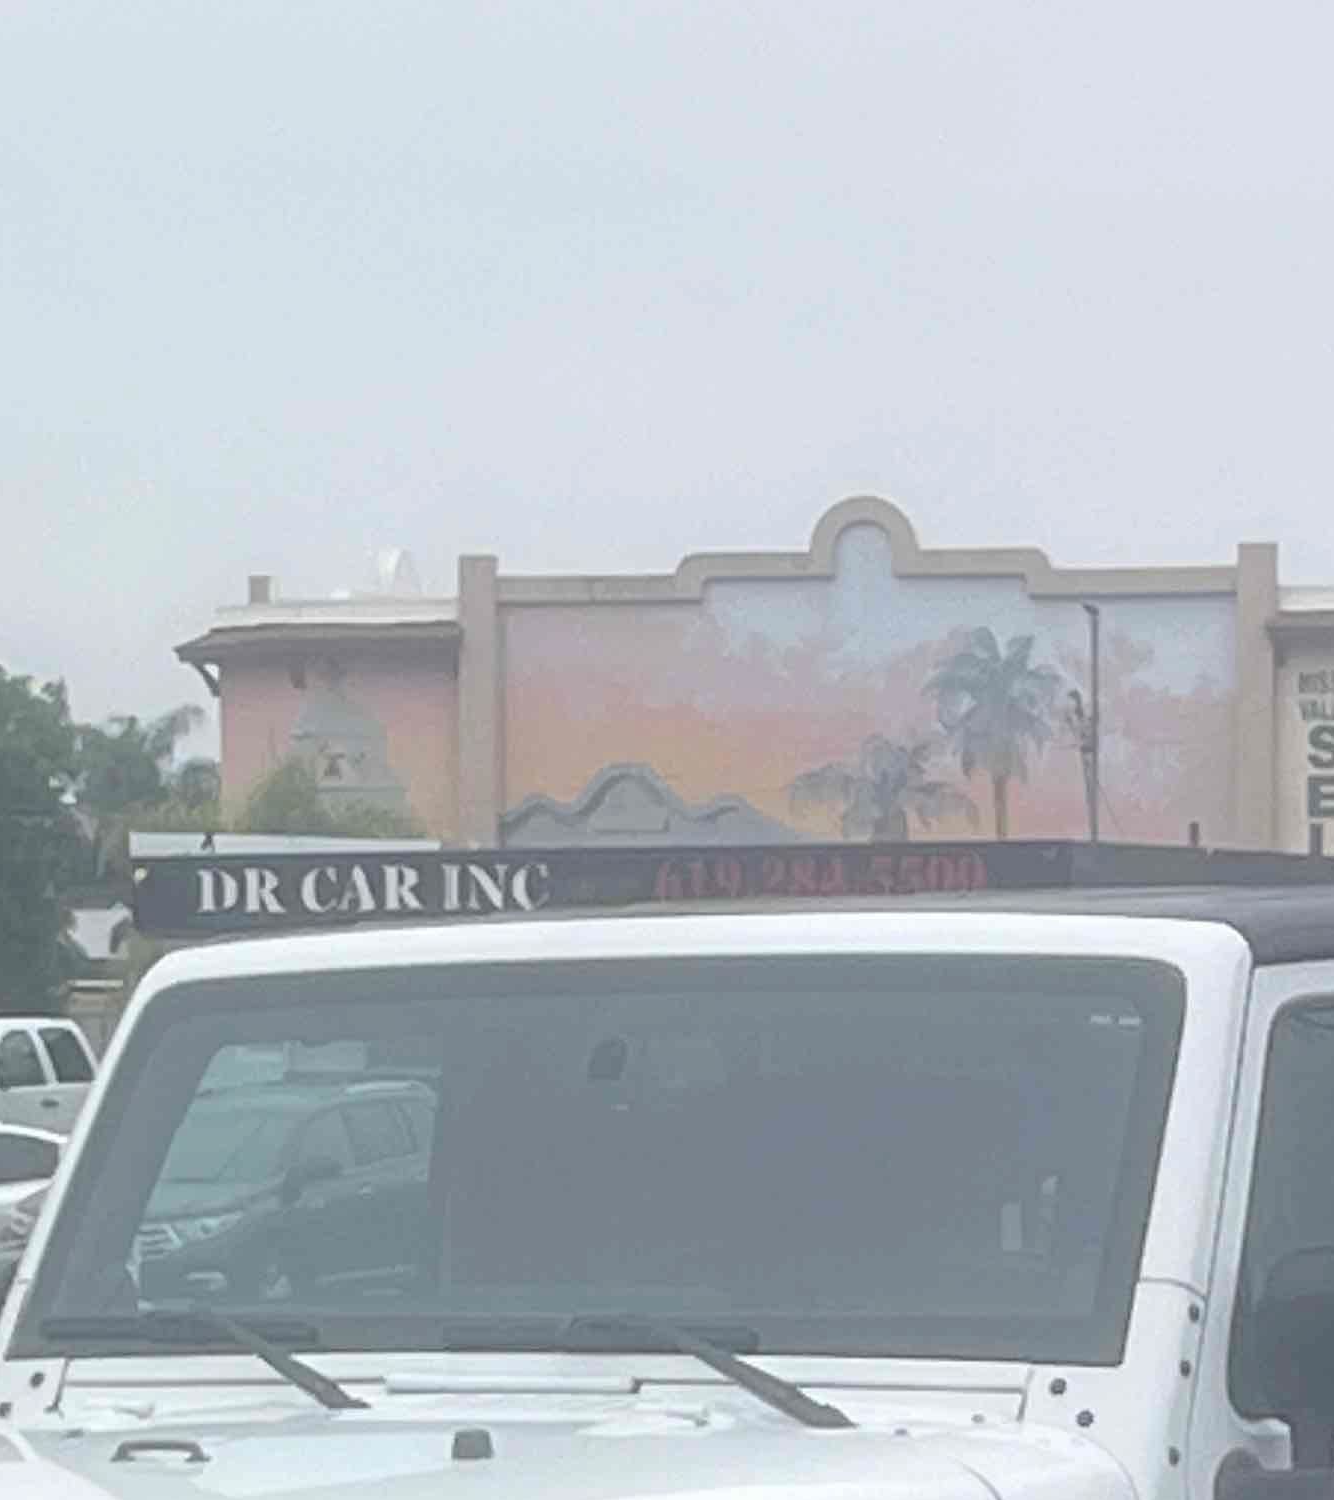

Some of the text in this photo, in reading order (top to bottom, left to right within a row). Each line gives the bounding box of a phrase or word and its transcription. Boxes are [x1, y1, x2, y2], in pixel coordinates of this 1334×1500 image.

[196, 865, 287, 914] DR
[300, 863, 423, 913] CAR
[440, 862, 551, 911] INC
